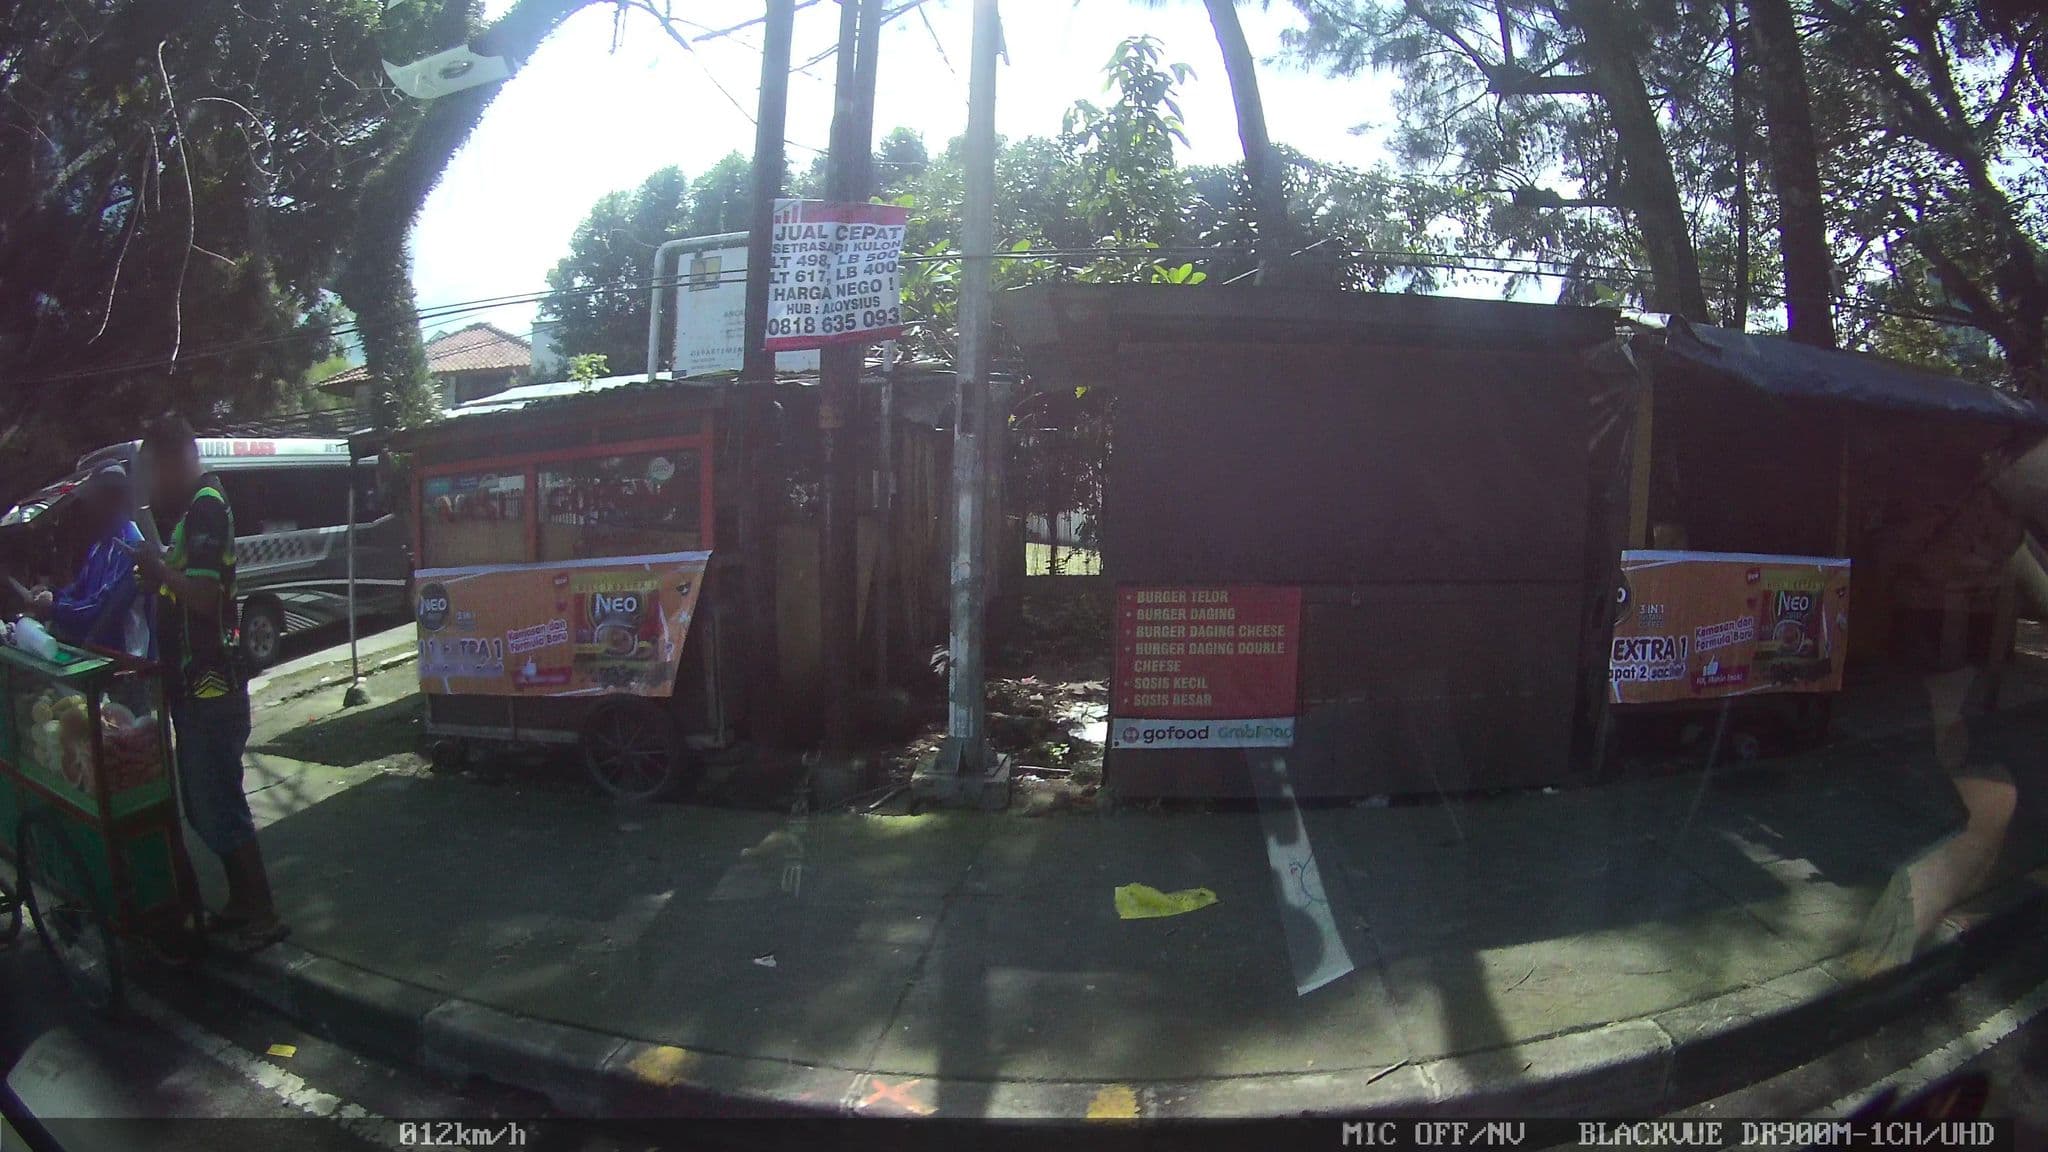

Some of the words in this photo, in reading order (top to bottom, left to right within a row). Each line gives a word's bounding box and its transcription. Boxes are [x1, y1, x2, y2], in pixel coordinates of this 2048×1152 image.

[776, 225, 828, 241] JUAL
[836, 226, 902, 241] CEPAT
[772, 242, 848, 255] SETRASARI
[854, 240, 901, 251] KULON
[770, 256, 791, 269] LT
[796, 255, 831, 269] 498,
[838, 254, 859, 266] LB
[865, 250, 898, 262] 500
[770, 272, 790, 284] LT
[795, 270, 831, 285] 617,
[836, 268, 858, 280] LB
[864, 260, 897, 276] 400
[774, 286, 832, 302] HARGA
[836, 280, 882, 298] NEGO
[786, 304, 812, 315] HUB
[822, 296, 880, 314] ALOYSIUS
[768, 317, 816, 336] 0818
[822, 312, 856, 333] 635
[862, 307, 900, 328] 093
[420, 596, 448, 614] NEO
[595, 593, 638, 616] NEO
[1137, 591, 1186, 604] BURGER
[1192, 591, 1228, 604] TELOR
[1778, 592, 1810, 616] NEO
[1137, 608, 1186, 620] BURGER
[1190, 608, 1236, 620] DAGING
[1136, 625, 1186, 638] BURGER
[1190, 625, 1234, 638] DAGING
[1238, 625, 1285, 638] CHEESE
[1696, 622, 1735, 638] Kemasan
[1738, 617, 1753, 628] dan
[1136, 642, 1185, 654] BURGER
[1189, 642, 1234, 654] DAGING
[1238, 642, 1284, 654] DOUBLE
[1696, 635, 1730, 650] Formula
[1734, 630, 1752, 641] Baru
[1614, 639, 1675, 662] EXTRA
[1680, 638, 1686, 658] 1
[1134, 660, 1182, 672] CHEESE
[1640, 666, 1646, 678] 2
[1134, 676, 1170, 689] SOSIS
[1174, 676, 1208, 689] KECIL
[1134, 694, 1169, 706] SOSIS
[1173, 694, 1212, 706] BESAR
[1144, 726, 1210, 744] gofood
